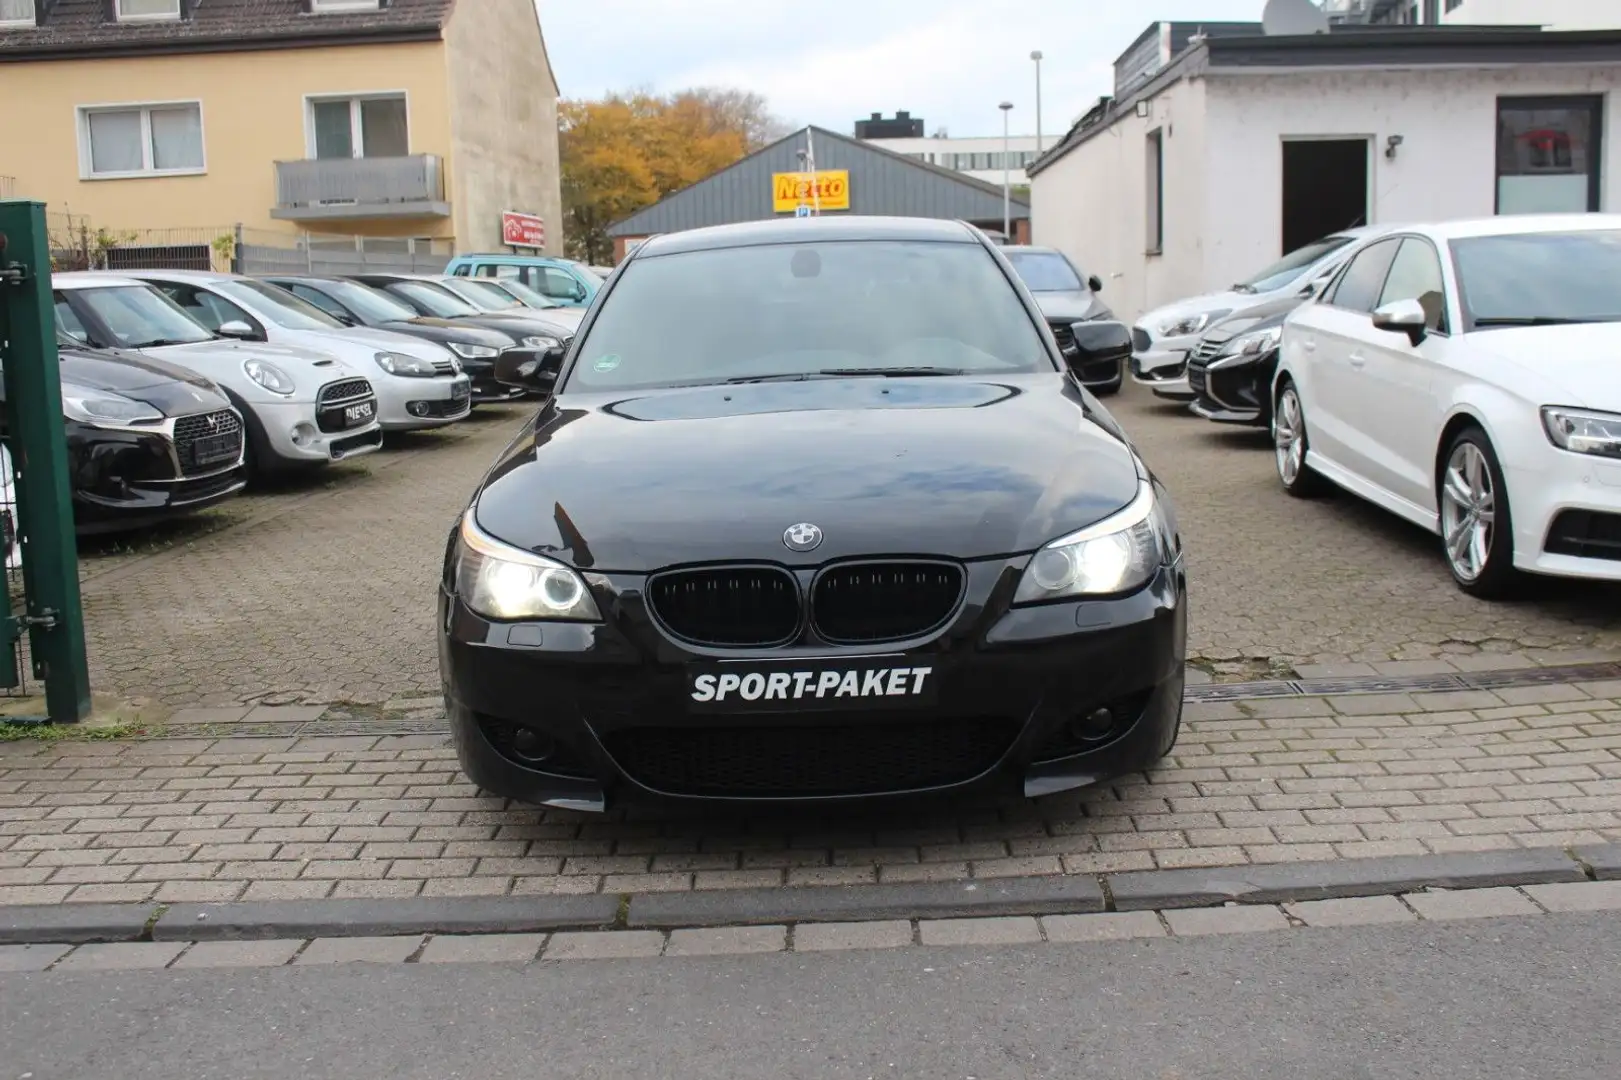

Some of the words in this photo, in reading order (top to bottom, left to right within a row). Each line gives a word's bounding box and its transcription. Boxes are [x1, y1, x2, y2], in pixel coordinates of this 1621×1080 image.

[777, 176, 845, 200] Netto
[346, 403, 373, 420] DIESEL
[691, 667, 933, 701] SPORT-PAKET
